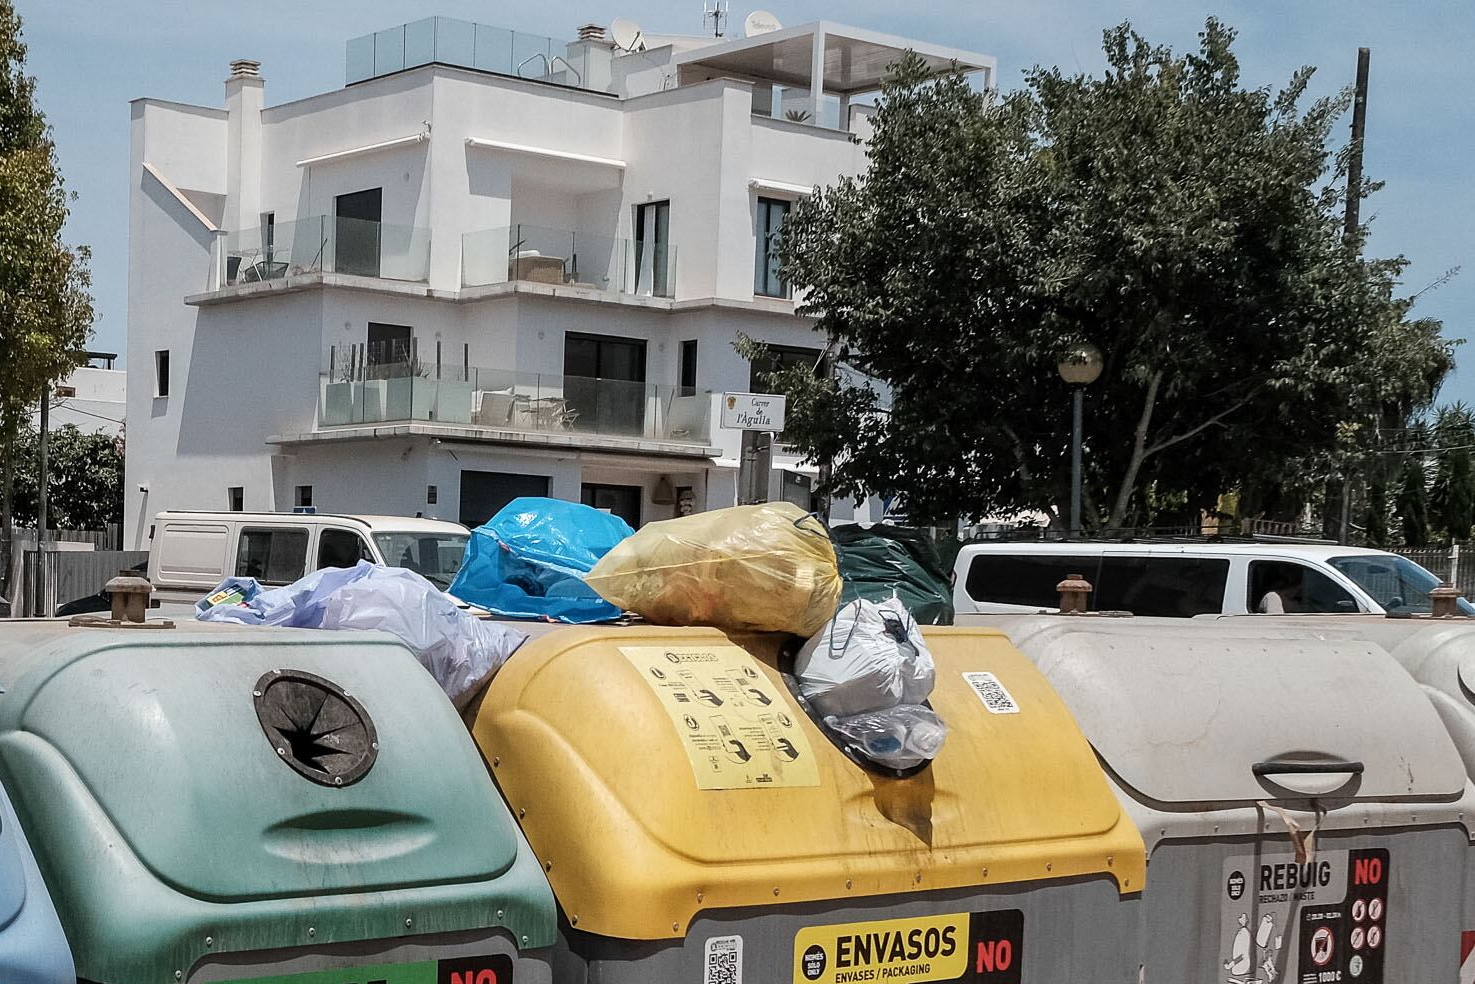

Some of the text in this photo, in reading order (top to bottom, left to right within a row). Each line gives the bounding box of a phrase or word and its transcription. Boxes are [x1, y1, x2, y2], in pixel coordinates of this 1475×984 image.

[751, 398, 770, 407] Carrer
[1260, 861, 1331, 891] REBUIG
[1354, 858, 1382, 885] NO
[836, 926, 957, 968] ENVASOS
[977, 940, 1012, 973] NO
[835, 971, 874, 984] ENVASES
[882, 963, 931, 979] PACKAGING
